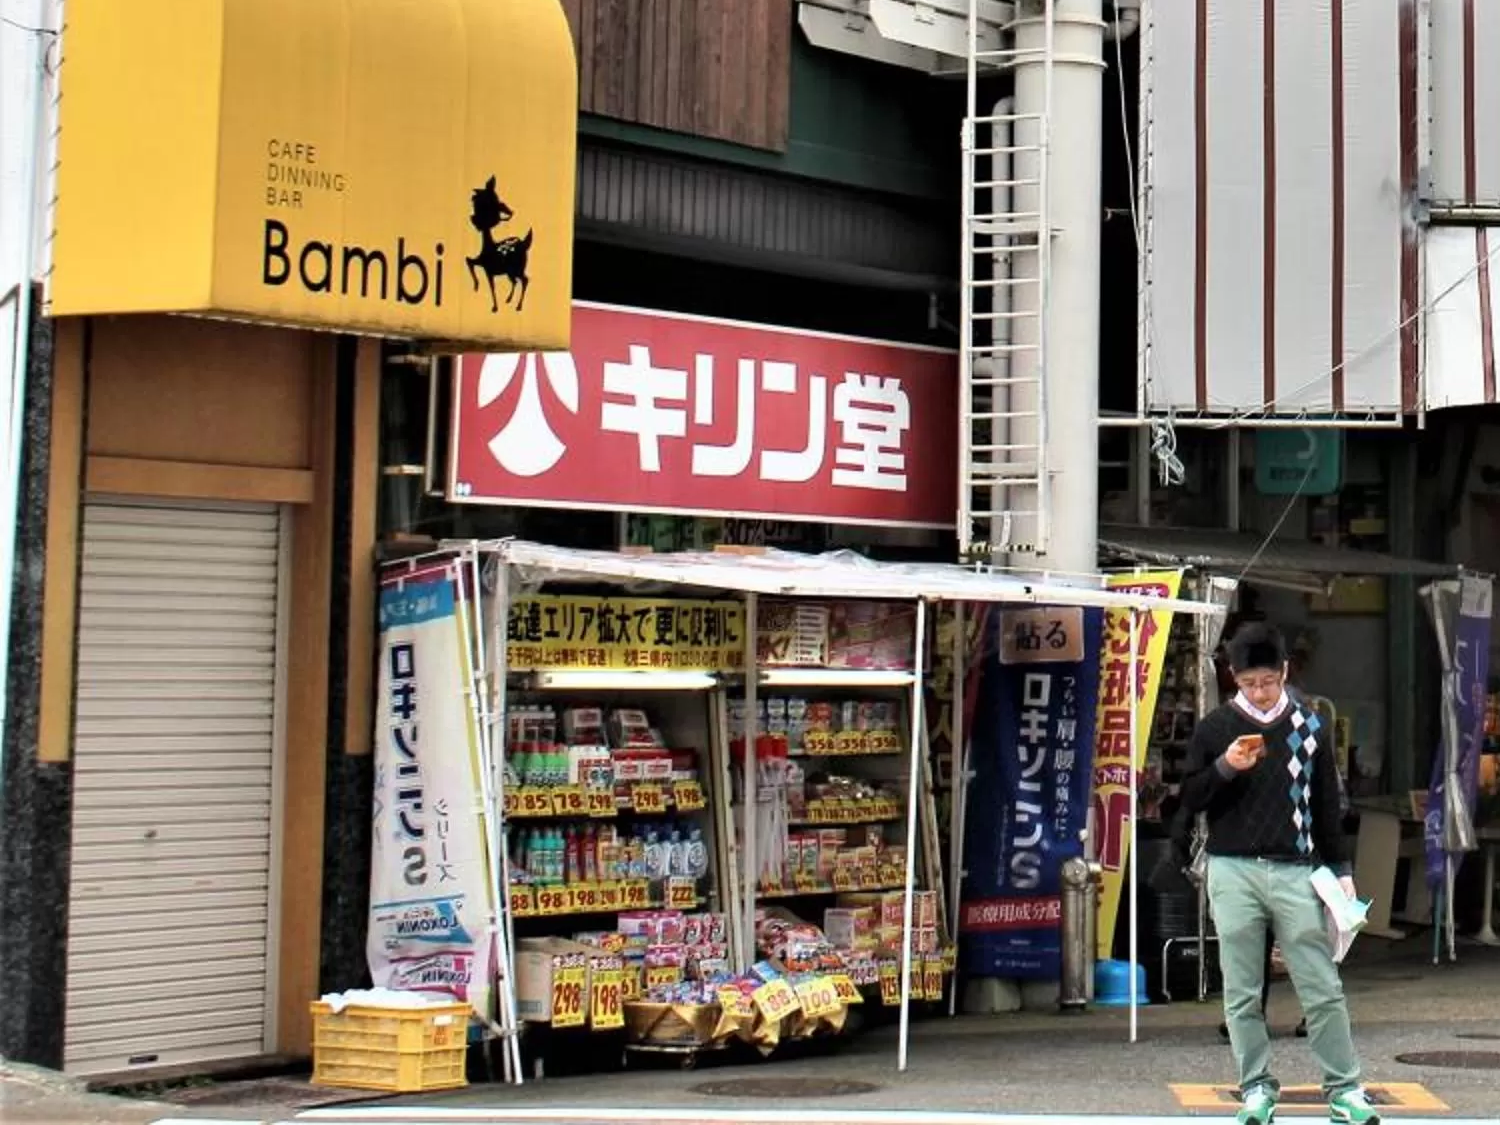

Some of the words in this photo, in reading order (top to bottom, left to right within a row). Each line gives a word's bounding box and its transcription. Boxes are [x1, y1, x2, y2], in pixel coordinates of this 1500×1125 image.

[267, 138, 317, 164] CAFE
[266, 162, 346, 192] DINNING
[265, 186, 304, 209] BAR
[263, 218, 445, 308] Bambi
[600, 344, 911, 492] キリン堂
[1014, 620, 1067, 652] 貼る
[1010, 672, 1052, 889] ロキソニンS
[555, 792, 582, 809] 78
[553, 982, 582, 1016] 298
[592, 982, 619, 1016] 198
